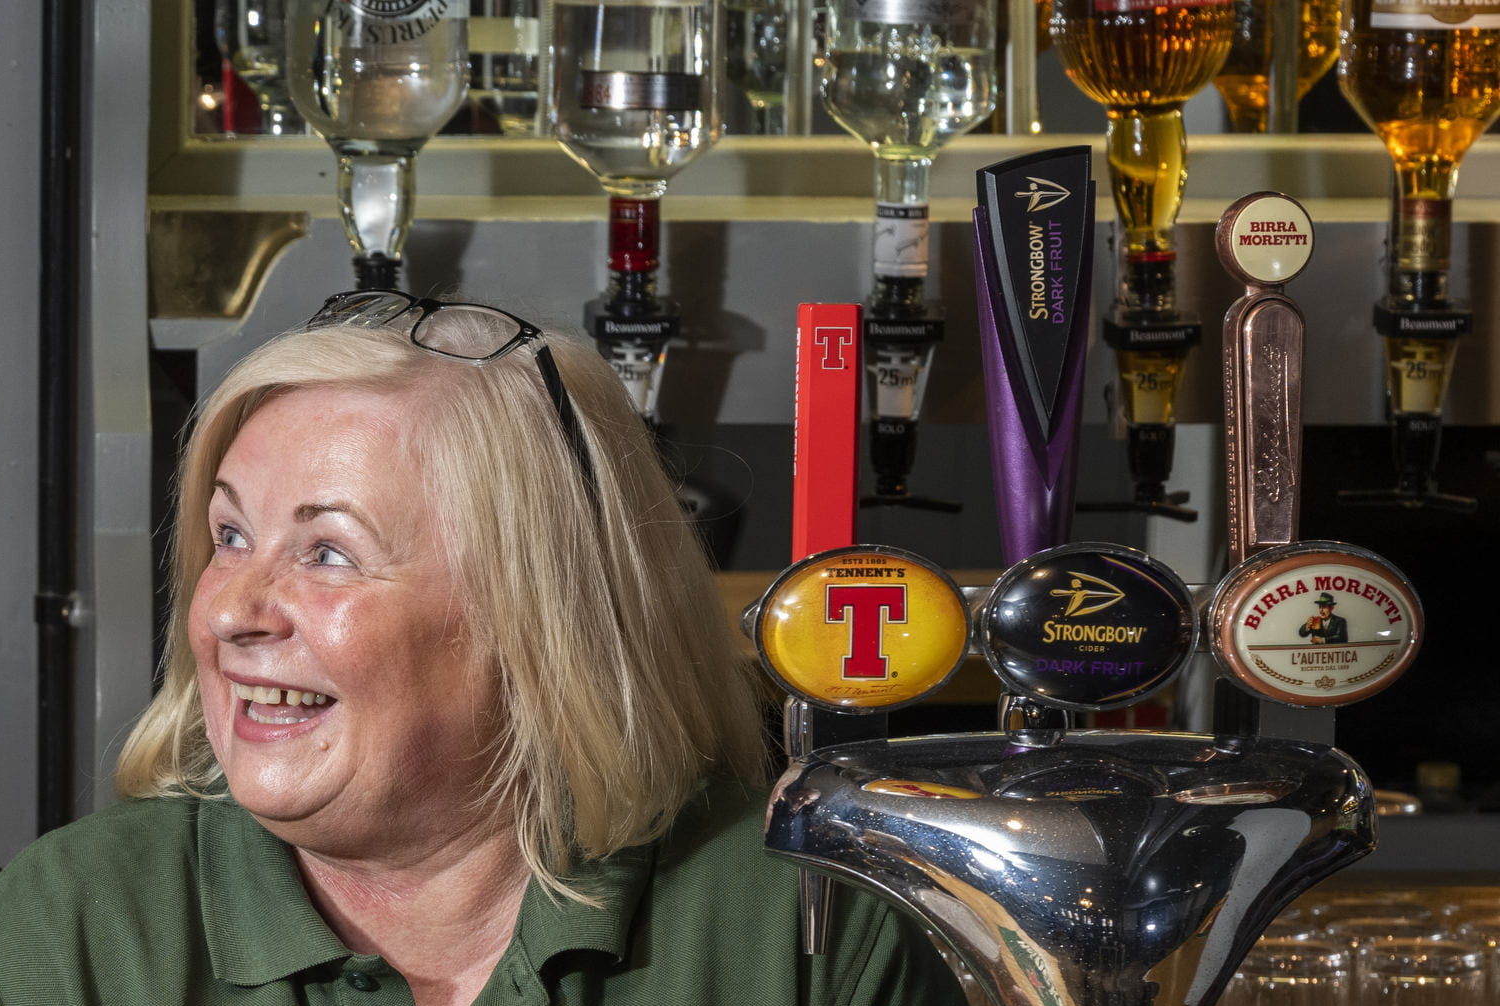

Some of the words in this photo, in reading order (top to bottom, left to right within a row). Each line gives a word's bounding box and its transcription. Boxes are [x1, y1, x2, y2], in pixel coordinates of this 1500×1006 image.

[1250, 221, 1297, 233] BIRRA
[1048, 219, 1063, 271] FRUIT
[1238, 234, 1308, 246] MORETTI
[1028, 224, 1049, 320] STRONGBOW
[1051, 275, 1065, 325] DARK
[815, 326, 853, 369] T
[825, 567, 906, 578] TENNENT'S
[1243, 579, 1309, 630] BIRRA
[1314, 575, 1404, 625] MORETTI
[825, 583, 908, 681] T
[1042, 620, 1143, 644] STRONGBOW
[1078, 645, 1105, 653] CIDER
[1291, 650, 1358, 666] L'AUTENTICA
[1034, 658, 1085, 673] DARK
[1091, 660, 1147, 676] FRUIT
